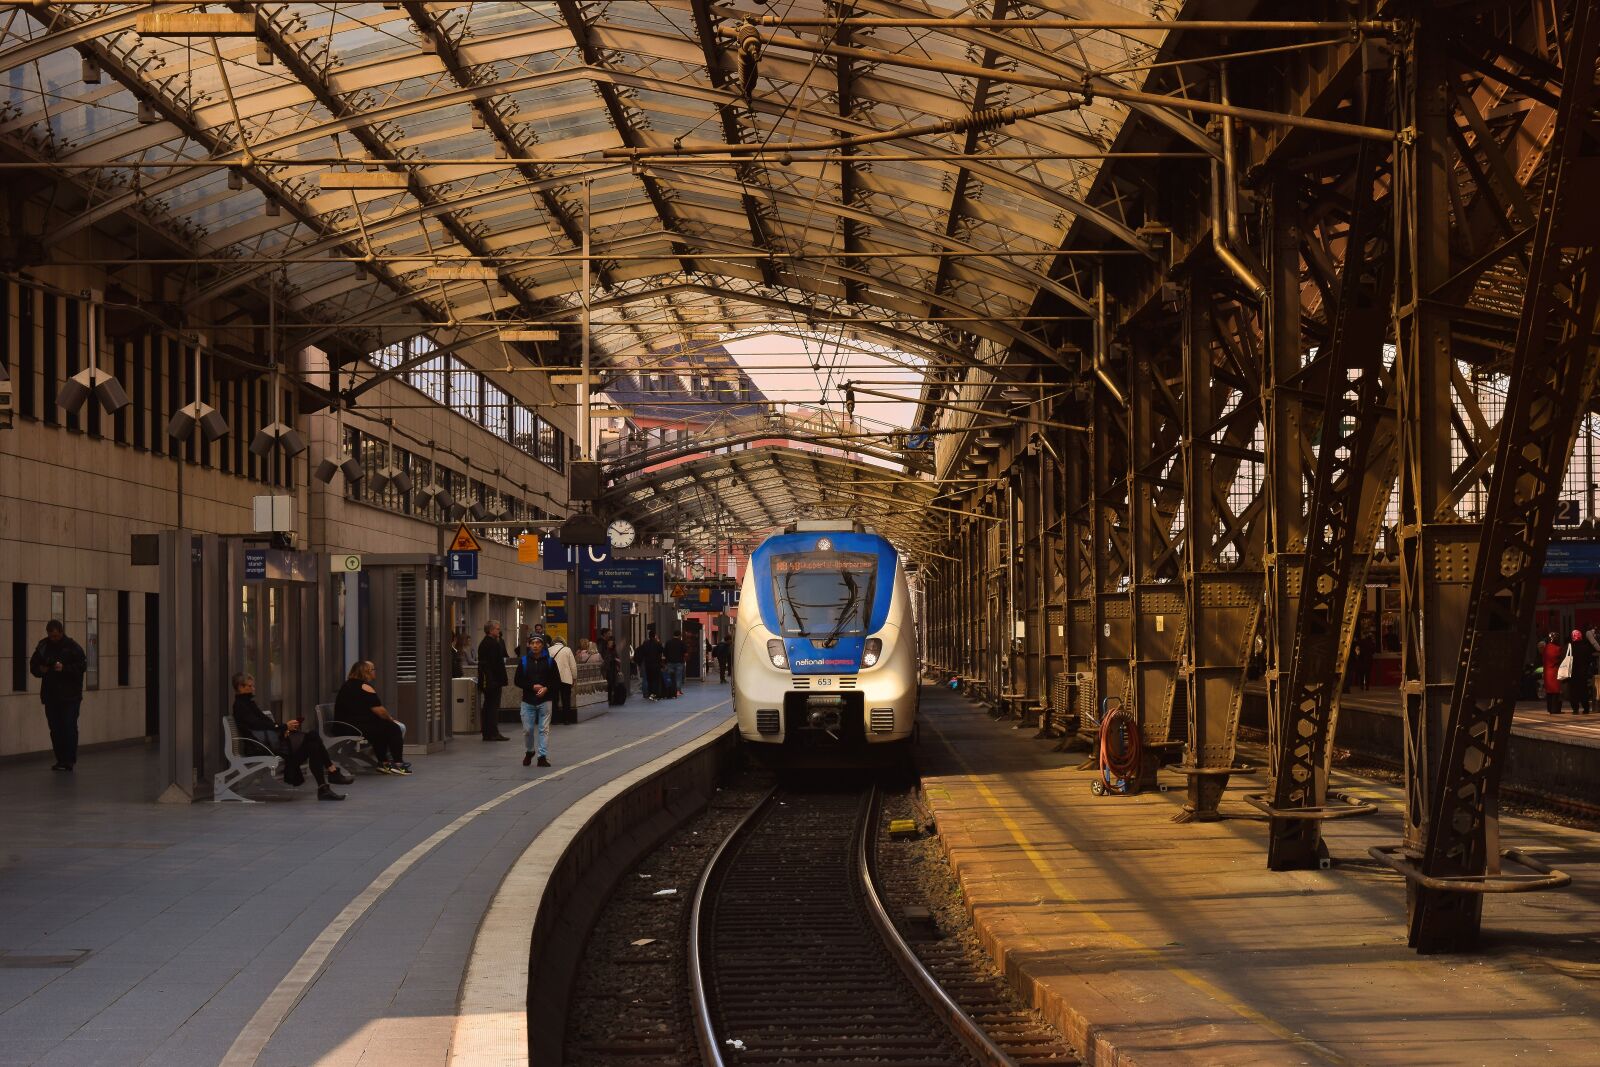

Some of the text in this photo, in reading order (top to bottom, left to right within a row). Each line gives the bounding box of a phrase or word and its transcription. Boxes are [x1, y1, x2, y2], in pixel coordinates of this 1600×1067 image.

[1557, 501, 1571, 520] 2
[720, 590, 726, 602] 1
[795, 658, 825, 666] national
[817, 678, 832, 686] 653
